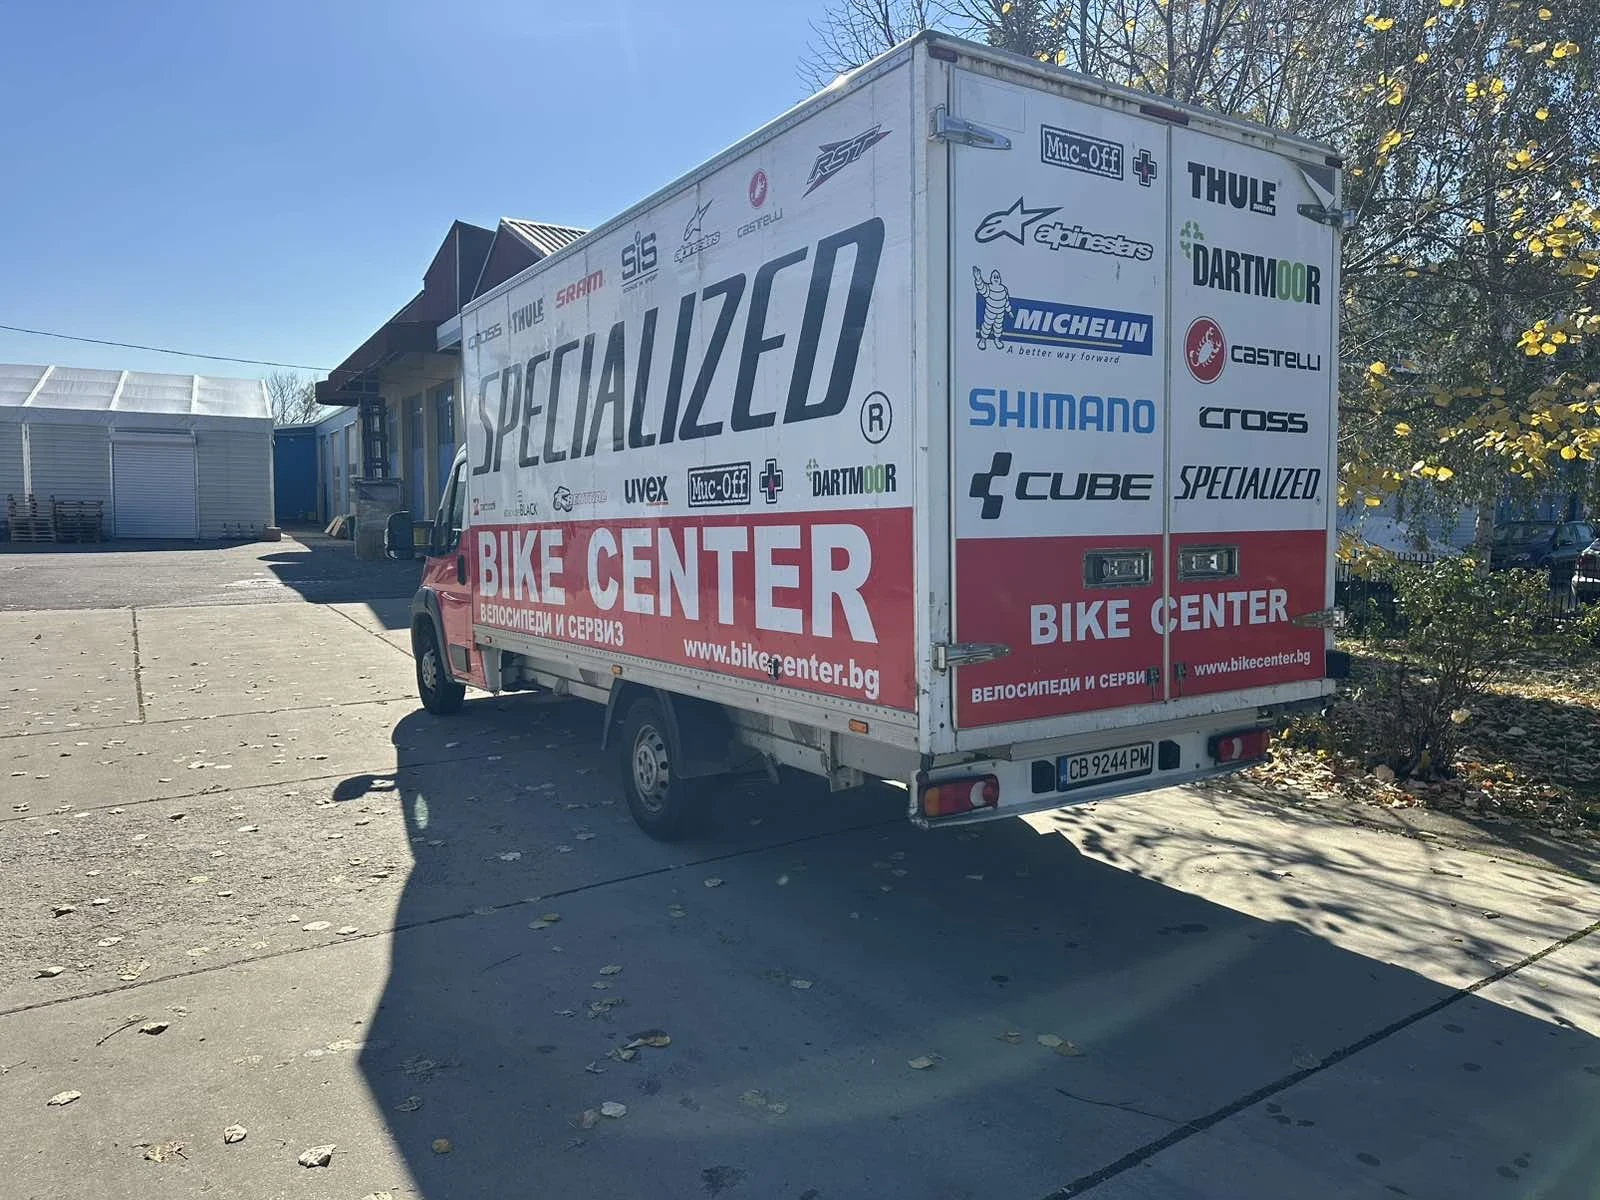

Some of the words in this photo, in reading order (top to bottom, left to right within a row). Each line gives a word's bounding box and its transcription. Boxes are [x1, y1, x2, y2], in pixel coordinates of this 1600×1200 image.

[806, 124, 882, 185] RST
[1046, 133, 1120, 177] Muc-Off
[1187, 160, 1276, 209] THULE
[1034, 222, 1154, 262] alpinestars
[555, 269, 604, 309] SRAM
[1192, 243, 1321, 305] DARTMOOR
[511, 298, 545, 334] THULE
[1013, 308, 1149, 343] MICHELIN
[472, 216, 886, 476] SPECIALIZED
[1006, 345, 1013, 354] A
[1018, 346, 1052, 358] better
[1056, 350, 1077, 362] way
[1080, 351, 1121, 364] forward
[968, 388, 1156, 434] SHIMANO
[624, 475, 669, 503] uvex
[691, 470, 748, 501] Muc-Off
[812, 463, 897, 497] DARTMOOR
[1014, 471, 1155, 501] CUBE
[1174, 465, 1321, 500] SPECIALIZED
[477, 528, 567, 606] BIKE
[587, 523, 879, 644] CENTER
[480, 602, 553, 637] ВЕЛОСИПЕДИ
[555, 614, 566, 637] И
[567, 614, 624, 646] СЕРВИЗ
[1030, 600, 1131, 646] BIKE
[1150, 588, 1289, 636] CENTER
[1194, 648, 1311, 677] www.bikecenter.bg
[971, 677, 1081, 703] ВЕЛОСИПЕДИ
[1085, 676, 1096, 690] И
[1099, 670, 1149, 689] СЕРВИ
[1092, 750, 1128, 776] 9244
